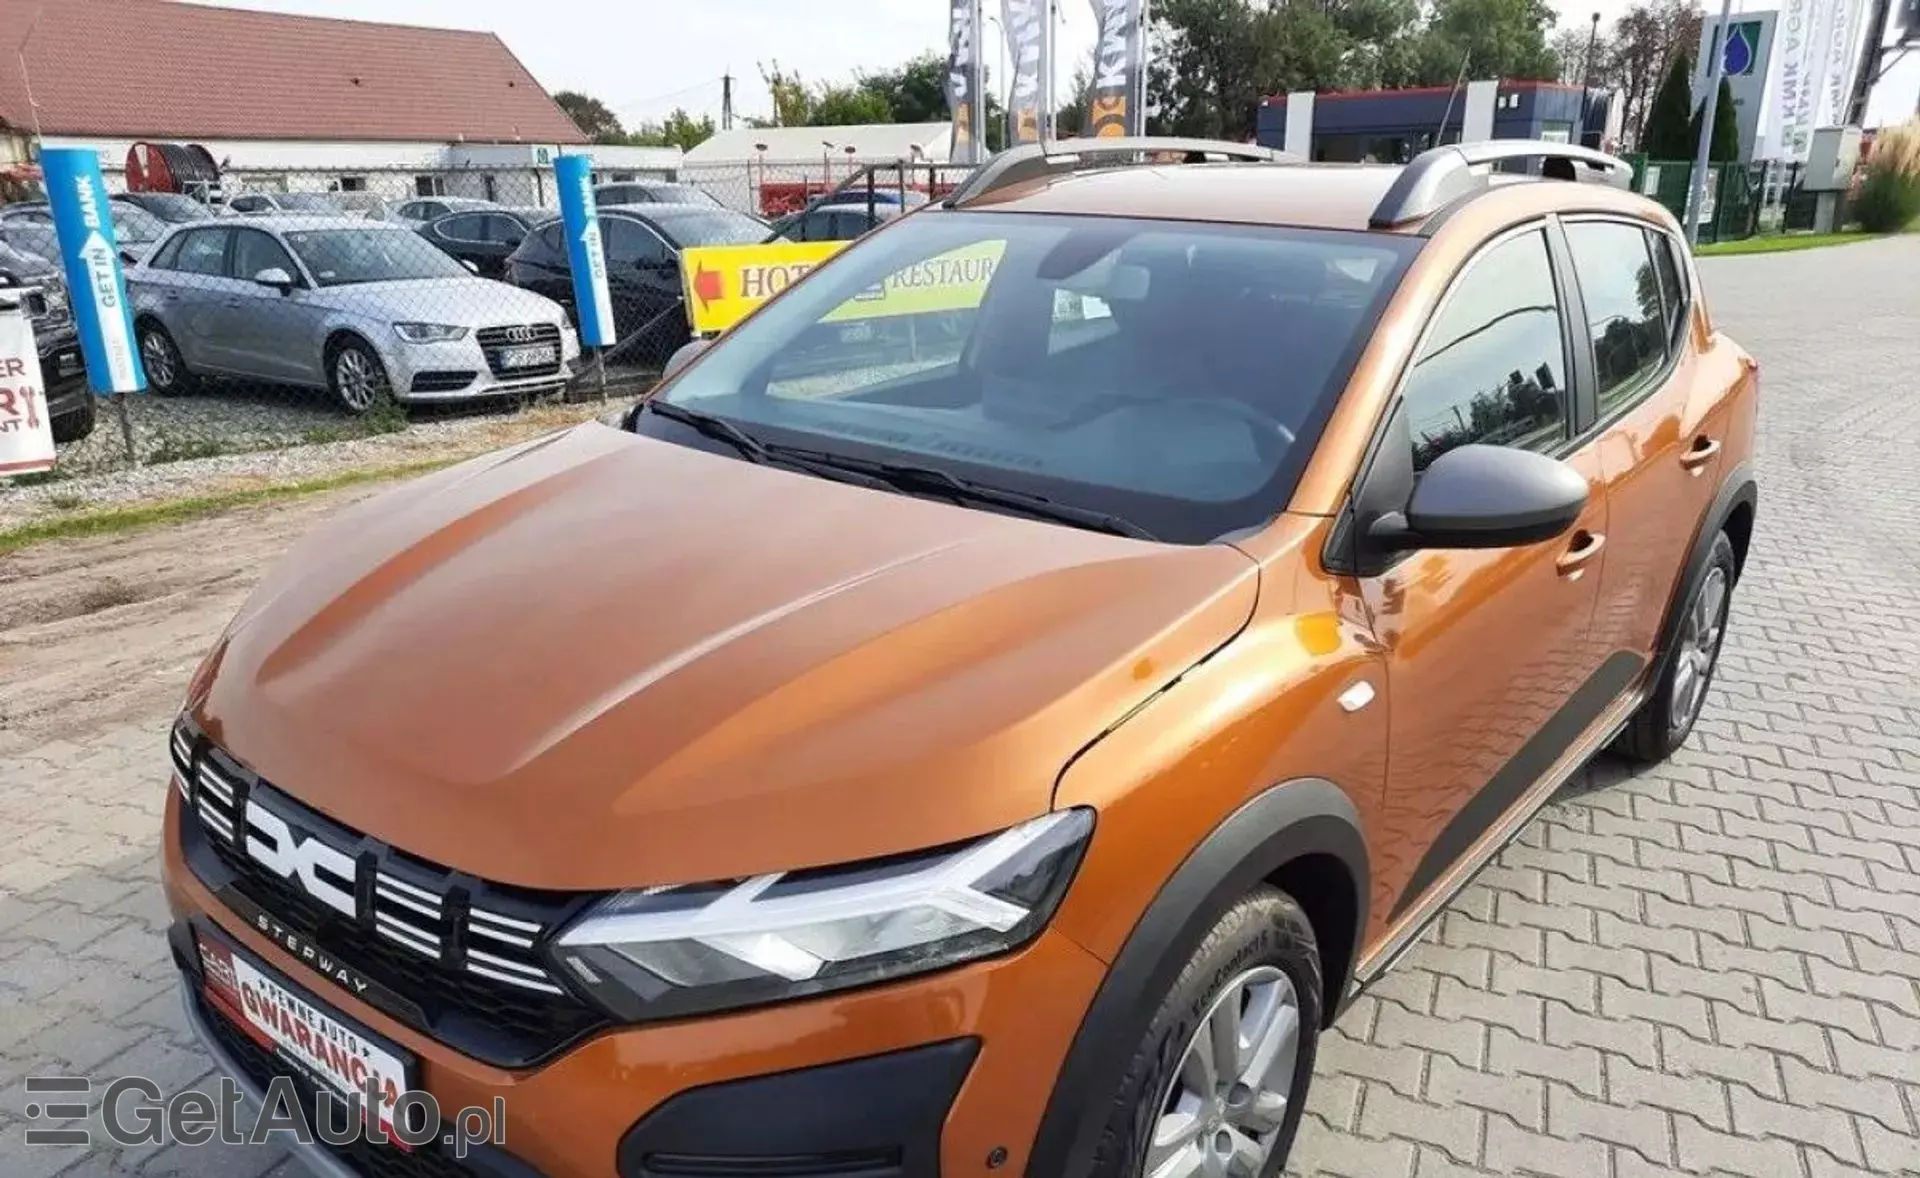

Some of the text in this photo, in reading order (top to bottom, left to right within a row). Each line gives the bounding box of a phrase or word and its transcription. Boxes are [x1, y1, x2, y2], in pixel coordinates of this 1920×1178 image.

[75, 174, 116, 308] GET IN BANK
[319, 1016, 357, 1056] AUTO
